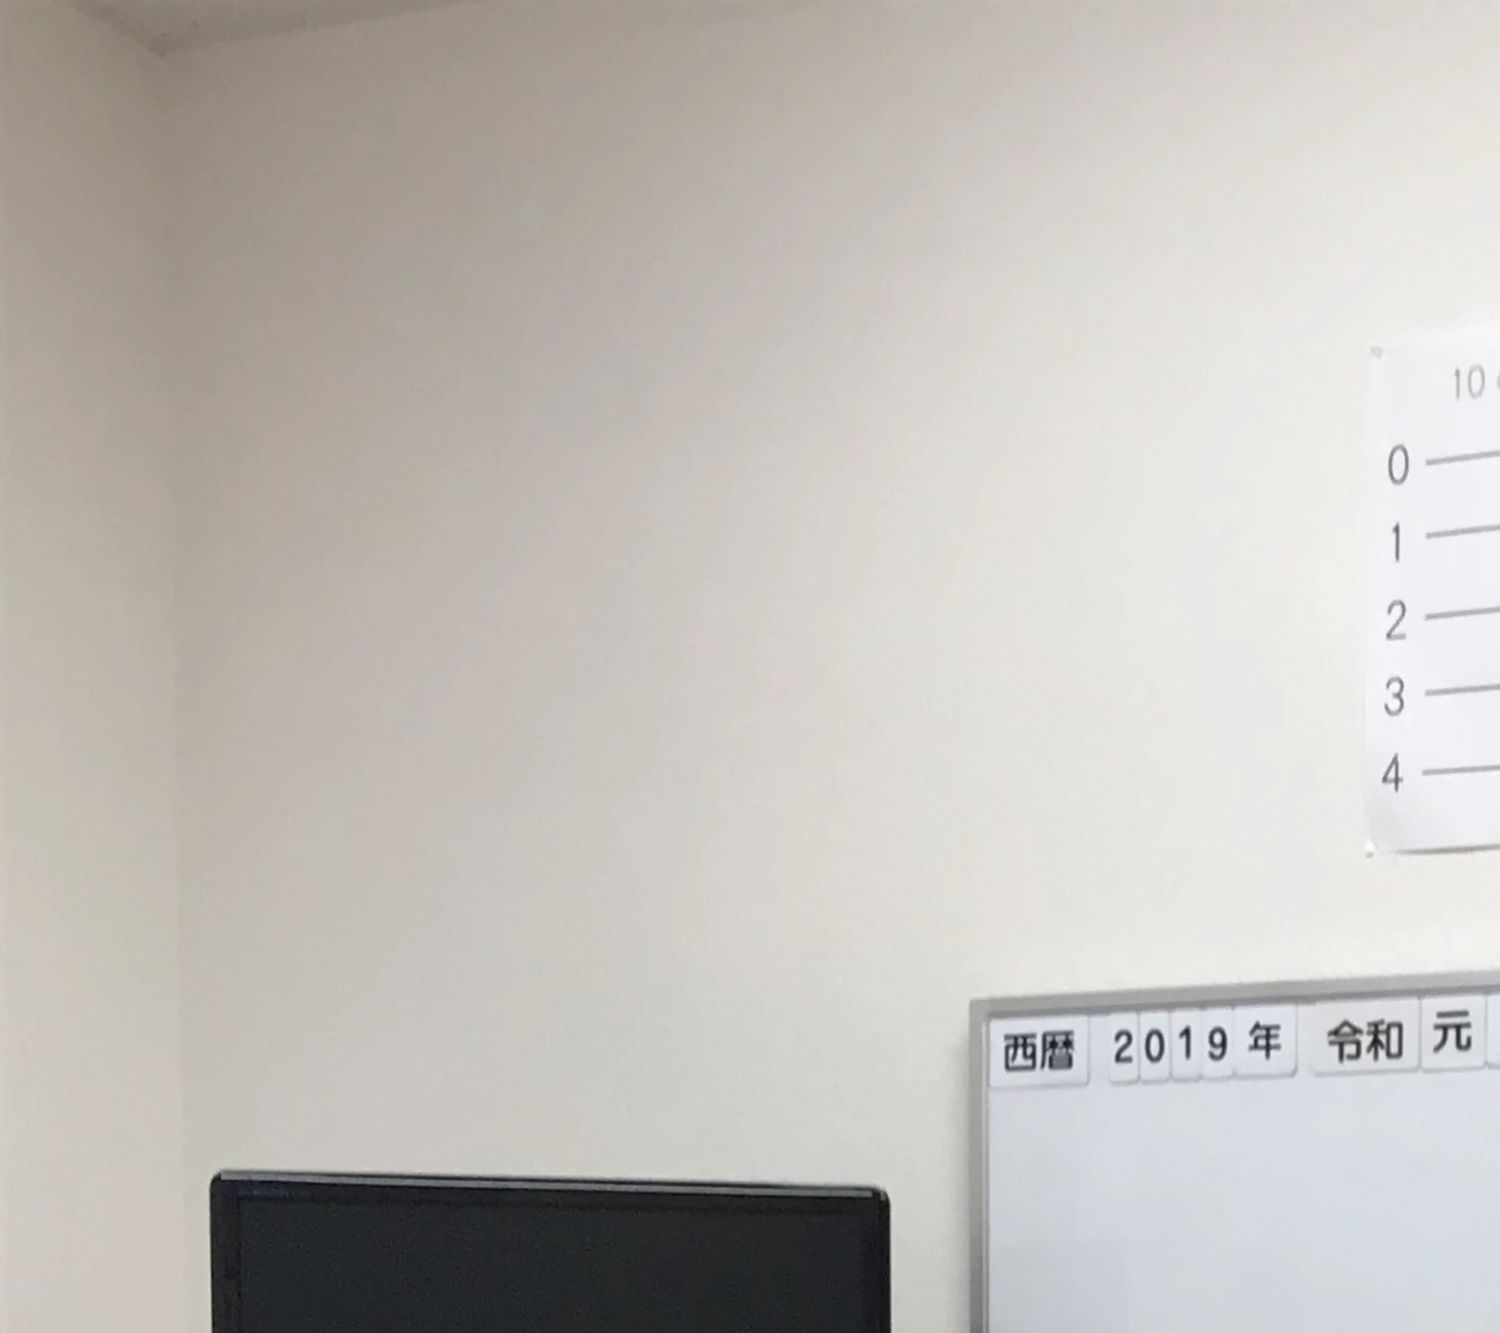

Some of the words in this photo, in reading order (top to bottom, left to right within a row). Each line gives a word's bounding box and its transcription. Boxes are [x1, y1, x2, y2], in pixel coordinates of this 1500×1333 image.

[1387, 444, 1410, 485] 0
[1391, 523, 1401, 562] 1
[1386, 600, 1407, 640] 2
[1384, 676, 1405, 716] 3
[1381, 754, 1404, 792] 4
[1003, 1030, 1075, 1072] 西暦
[1113, 1020, 1281, 1064] 2019年
